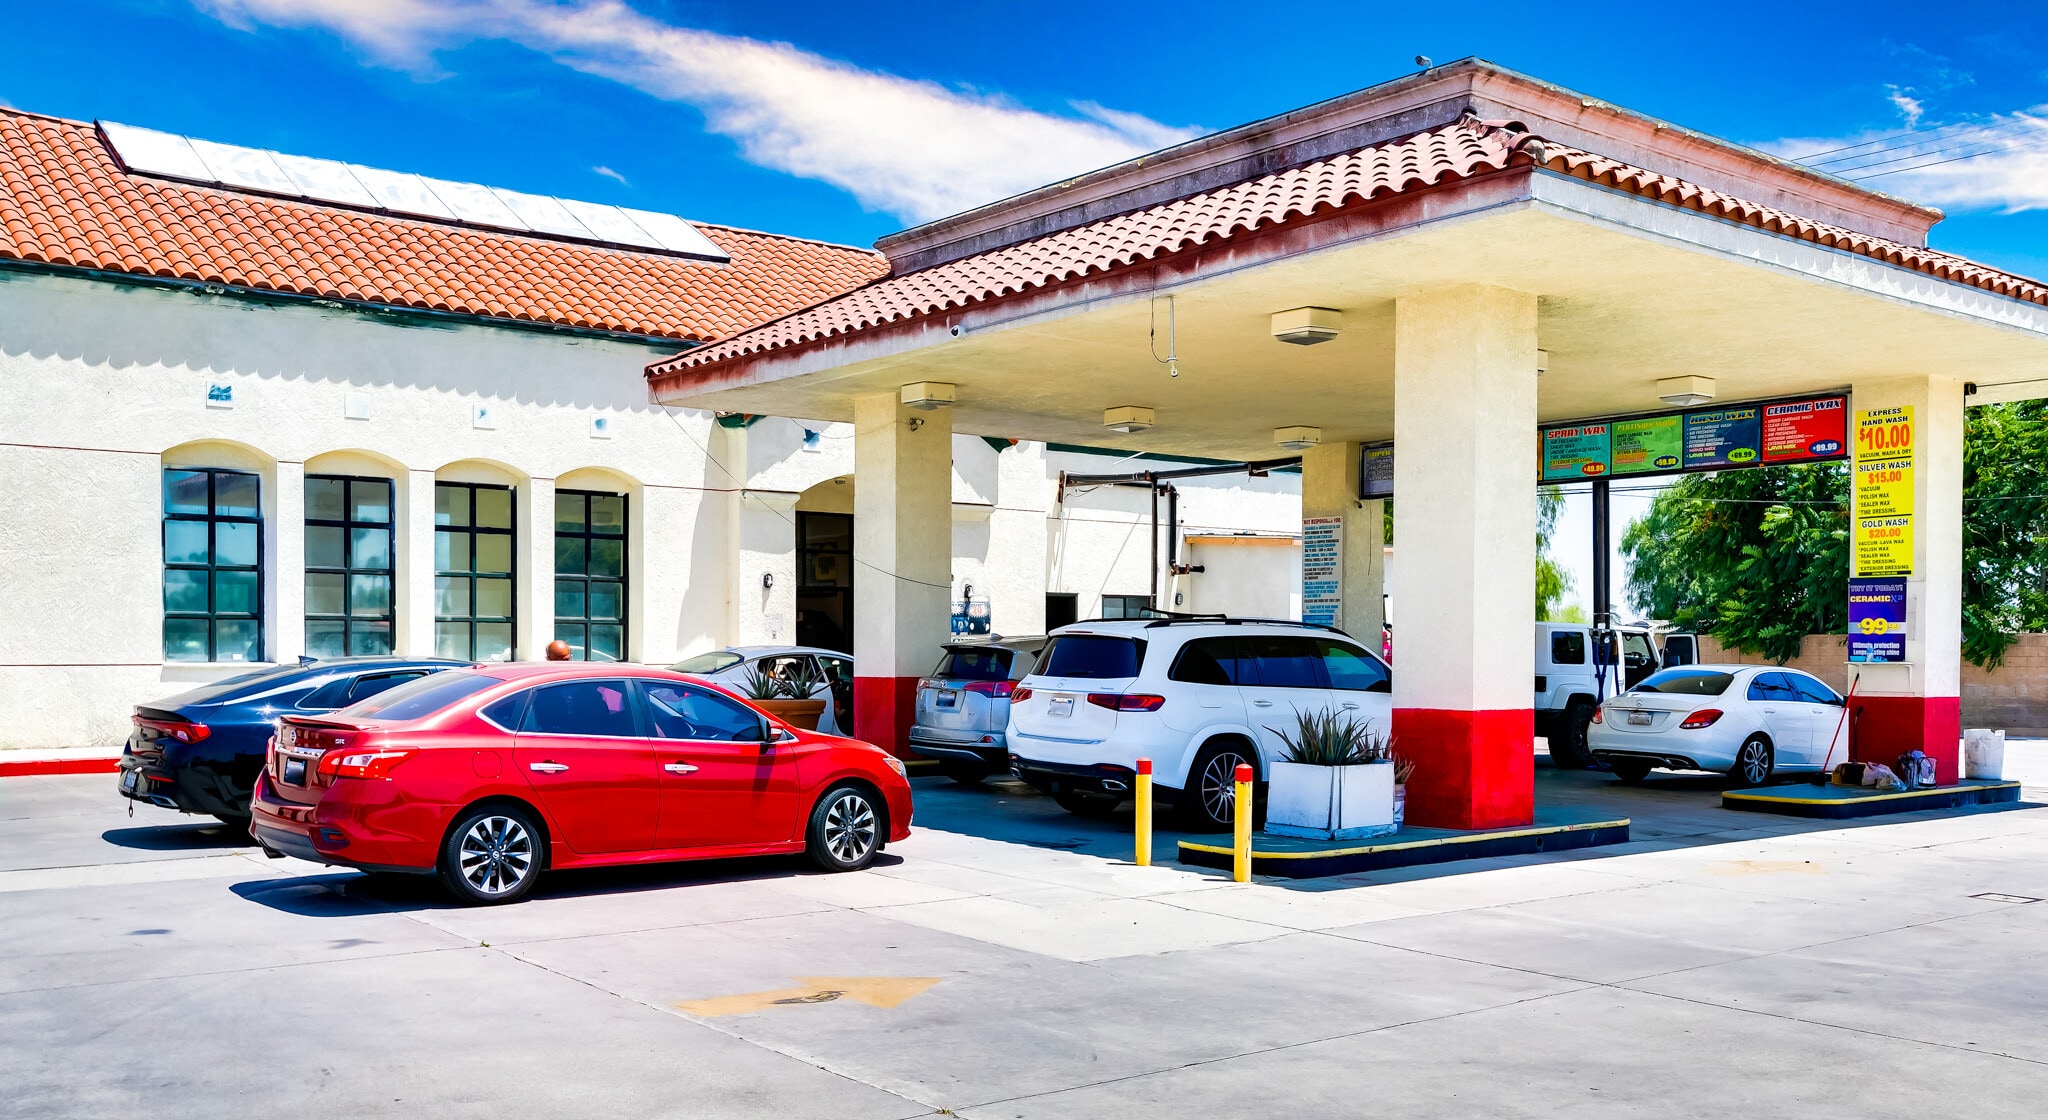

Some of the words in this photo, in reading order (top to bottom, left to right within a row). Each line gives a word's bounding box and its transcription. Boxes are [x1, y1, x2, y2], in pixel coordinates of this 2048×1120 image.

[1766, 402, 1813, 416] CERAMIC
[1814, 399, 1842, 411] WAX
[1868, 408, 1902, 417] EXPRESS
[1689, 413, 1723, 424] HAND
[1725, 409, 1755, 420] WAX
[1547, 428, 1579, 439] SPRAY
[1582, 425, 1606, 435] WAX
[1860, 424, 1910, 450] $10.00
[1813, 443, 1837, 451] $99.99
[1859, 463, 1886, 472] SILVER
[1888, 461, 1911, 469] WASH
[1869, 470, 1901, 485] $15.00
[1862, 520, 1883, 528] GOLD
[1885, 518, 1908, 526] WASH
[1869, 528, 1901, 539] $20.00
